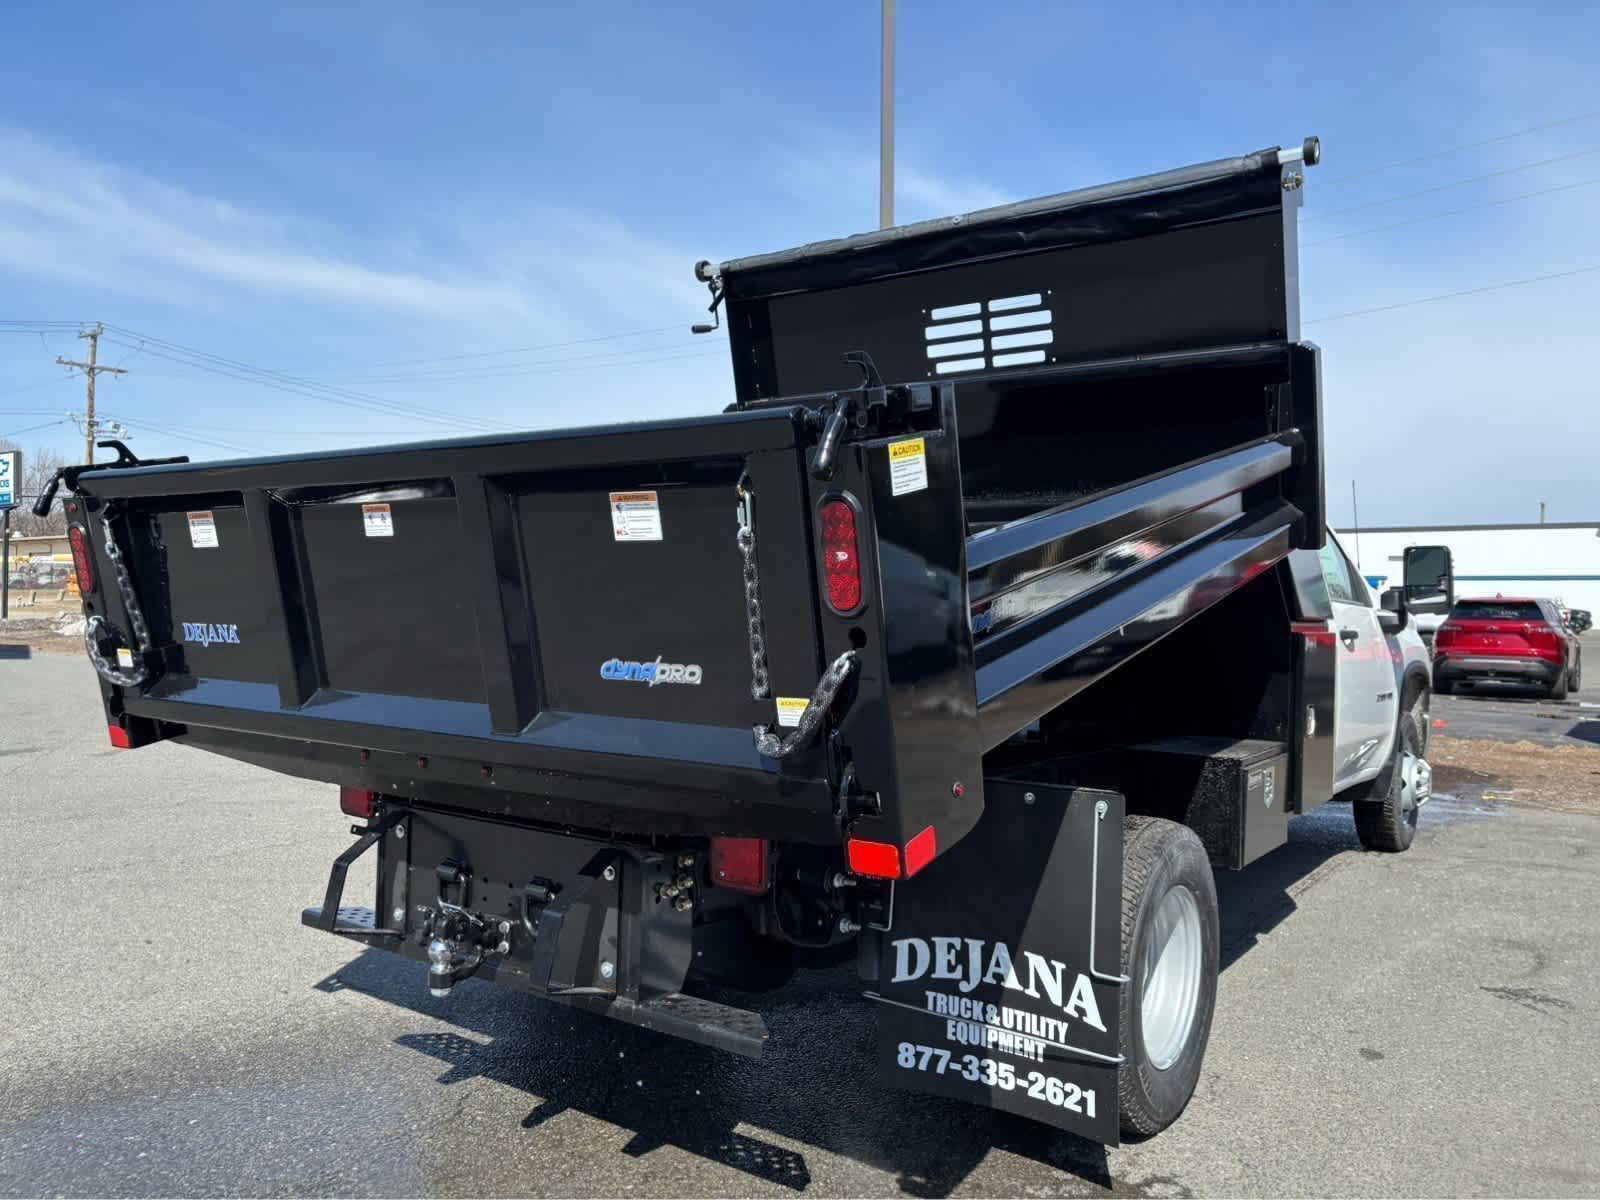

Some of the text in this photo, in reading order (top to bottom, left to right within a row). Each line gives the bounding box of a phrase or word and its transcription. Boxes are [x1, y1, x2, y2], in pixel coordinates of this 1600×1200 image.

[182, 622, 240, 648] DEJANA
[891, 936, 1108, 1033] DEJANA
[946, 1019, 1047, 1063] EQUIPMENT
[897, 1041, 1096, 1119] 877-335-2621
